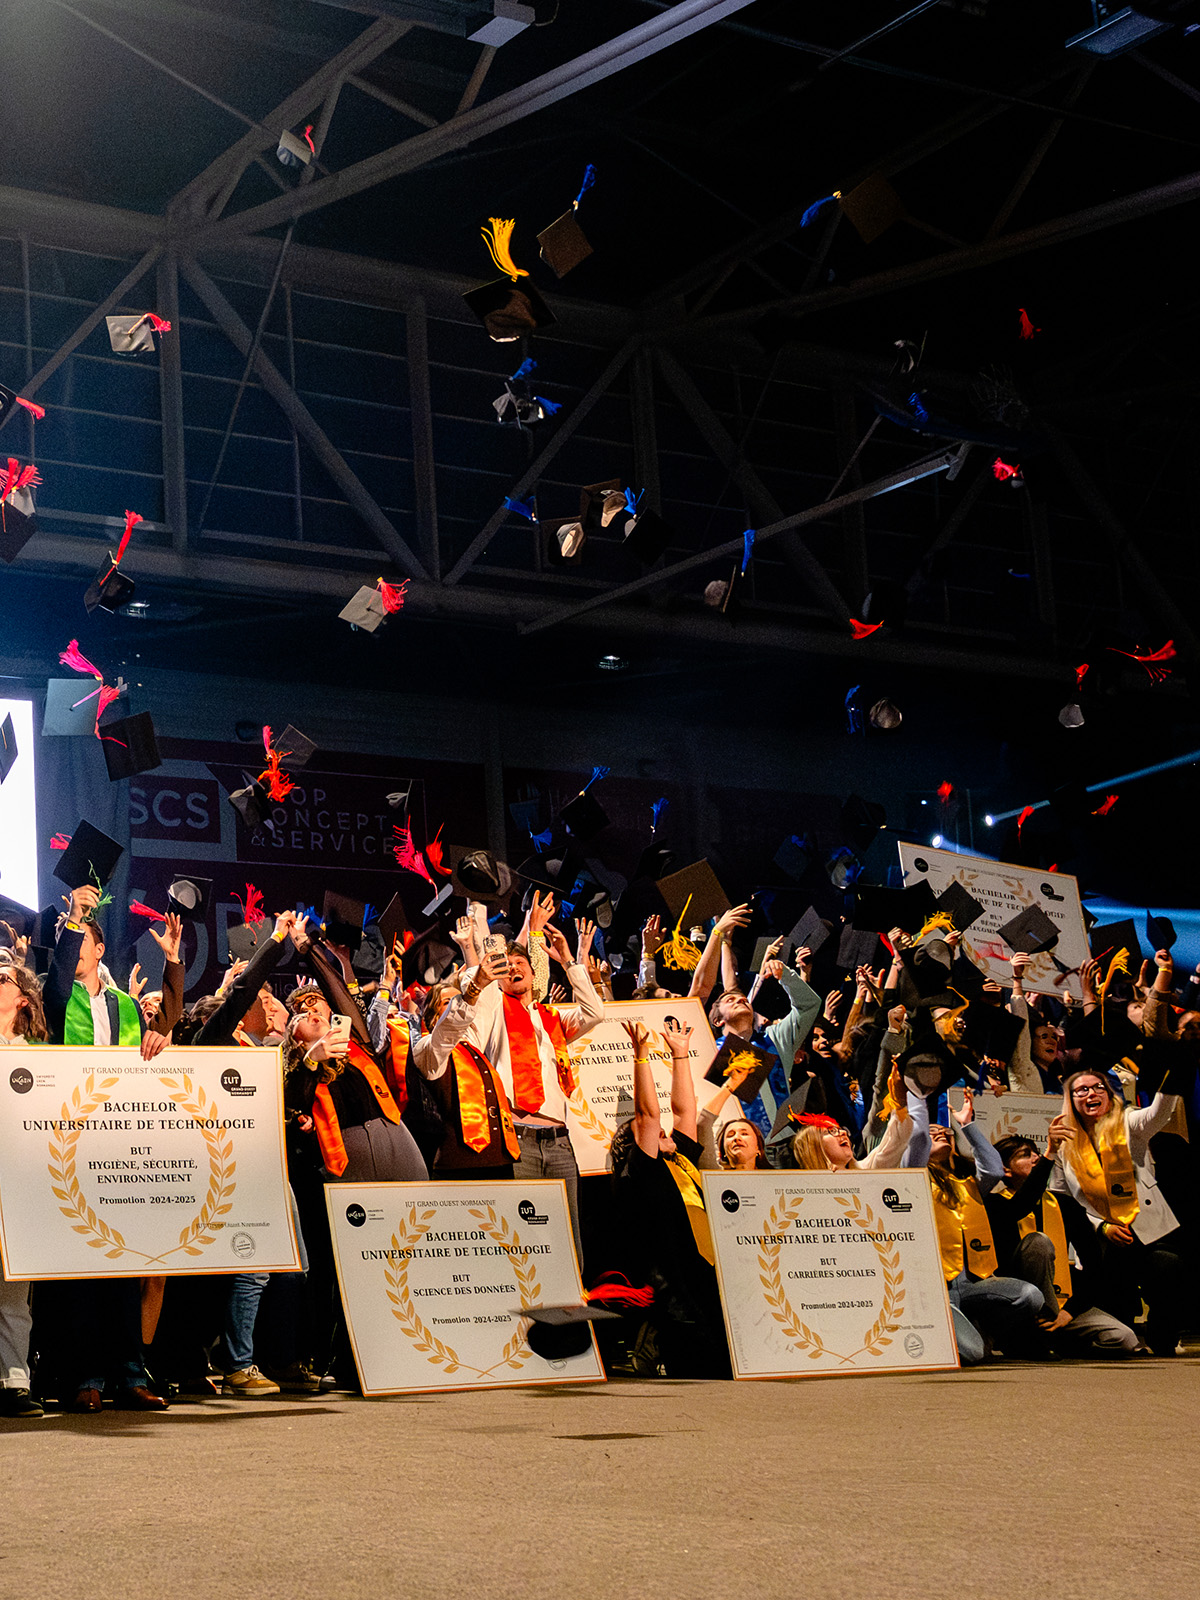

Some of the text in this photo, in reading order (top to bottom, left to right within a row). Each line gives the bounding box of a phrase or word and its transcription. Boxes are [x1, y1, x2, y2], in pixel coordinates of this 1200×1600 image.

[290, 788, 326, 806] OP
[272, 807, 387, 831] ONCEPT
[590, 1042, 634, 1051] BACHELO
[616, 1055, 629, 1063] DE
[224, 1076, 239, 1085] IUT
[104, 1102, 177, 1113] BACHELOR
[22, 1118, 255, 1131] UNIVERSITAIRE DE TECHNOLOGIE
[130, 1146, 152, 1155] BUT
[88, 1158, 198, 1171] HYGIÈNE, SÉCURITÉ,
[97, 1174, 192, 1184] ENVIRONNEMENT
[99, 1196, 196, 1205] Promotion 2024-2025
[795, 1218, 852, 1228] BACHELOR
[426, 1231, 486, 1242] BACHELOR
[736, 1232, 916, 1246] UNIVERSITAIRE DE TECHNOLOGIE
[361, 1244, 552, 1260] UNIVERSITAIRE DE TECHNOLOGIE
[452, 1274, 471, 1282] BUT
[787, 1269, 876, 1279] CARRIÈRES SOCIALES
[413, 1283, 516, 1297] SCIENCE DES DONNÉES
[801, 1300, 873, 1310] Promotion 2024-2025
[432, 1314, 512, 1325] Promotion 2024-2025
